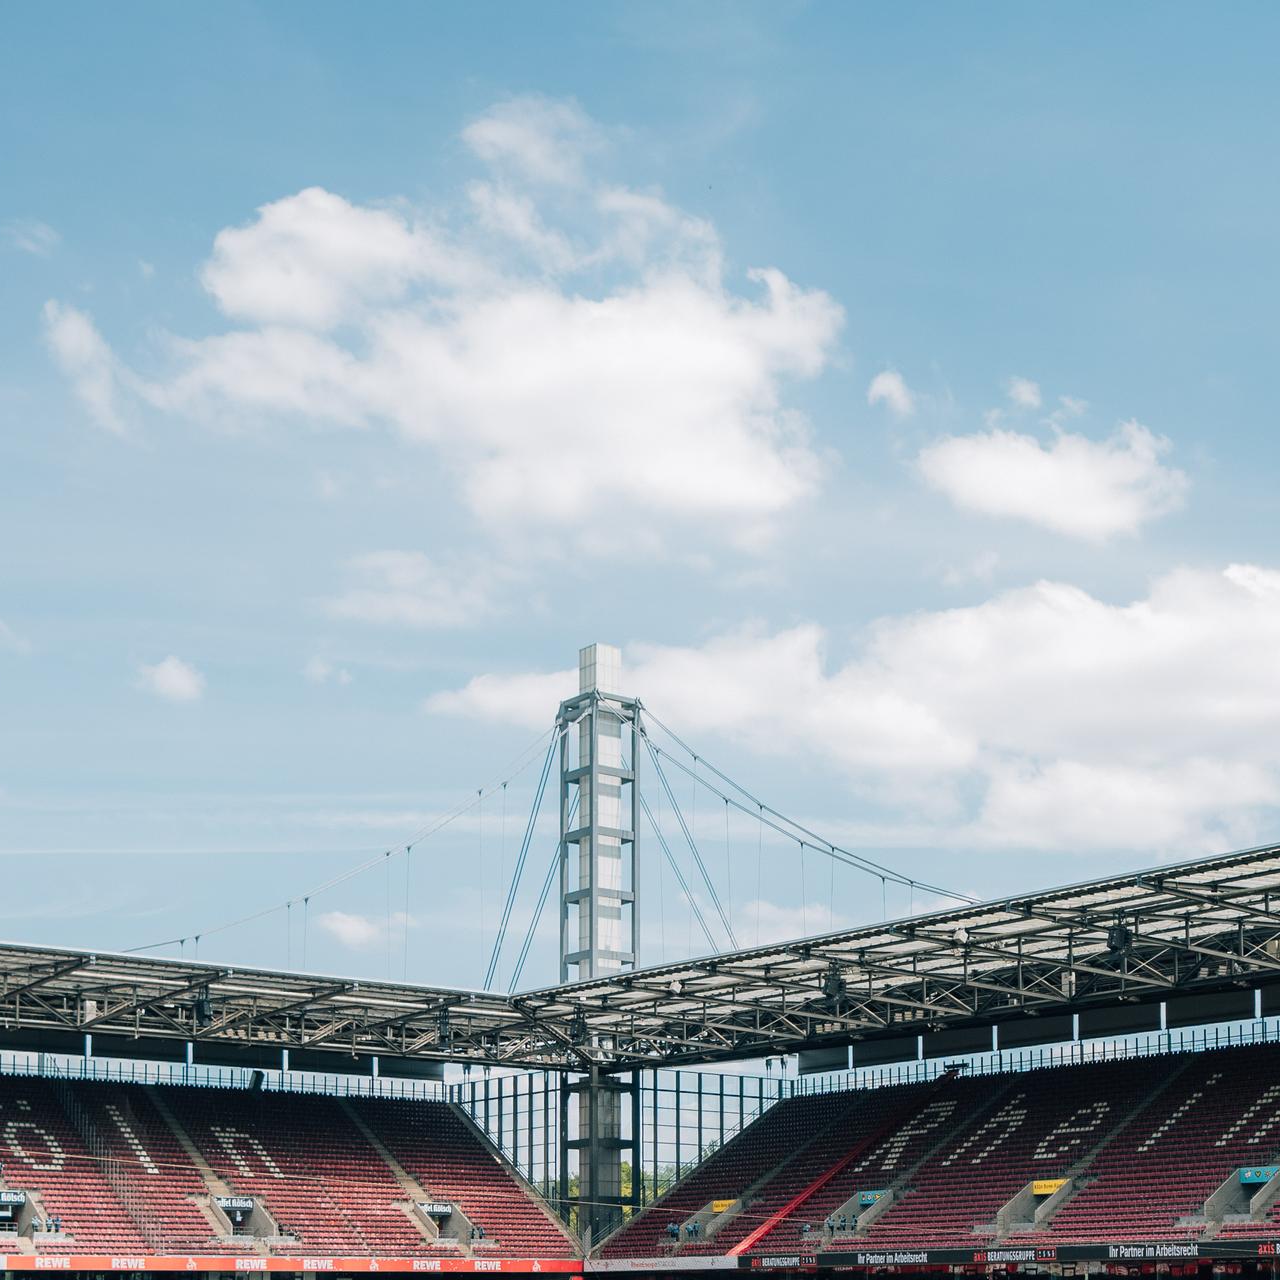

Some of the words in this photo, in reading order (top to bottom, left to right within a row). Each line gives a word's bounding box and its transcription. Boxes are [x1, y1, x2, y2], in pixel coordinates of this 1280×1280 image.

[1109, 1246, 1118, 1258] Ihr
[1120, 1245, 1144, 1258] Partner
[1145, 1244, 1154, 1257] im
[1155, 1243, 1198, 1256] Arbeitsrecht
[1258, 1242, 1275, 1254] axis
[987, 1250, 1035, 1261] BERATUNGSGRUPPE
[35, 1257, 71, 1268] REWE
[112, 1258, 145, 1268] REWE
[236, 1259, 267, 1269] REWE
[304, 1259, 333, 1269] REWE
[413, 1260, 441, 1271] REWE
[474, 1260, 501, 1271] REWE
